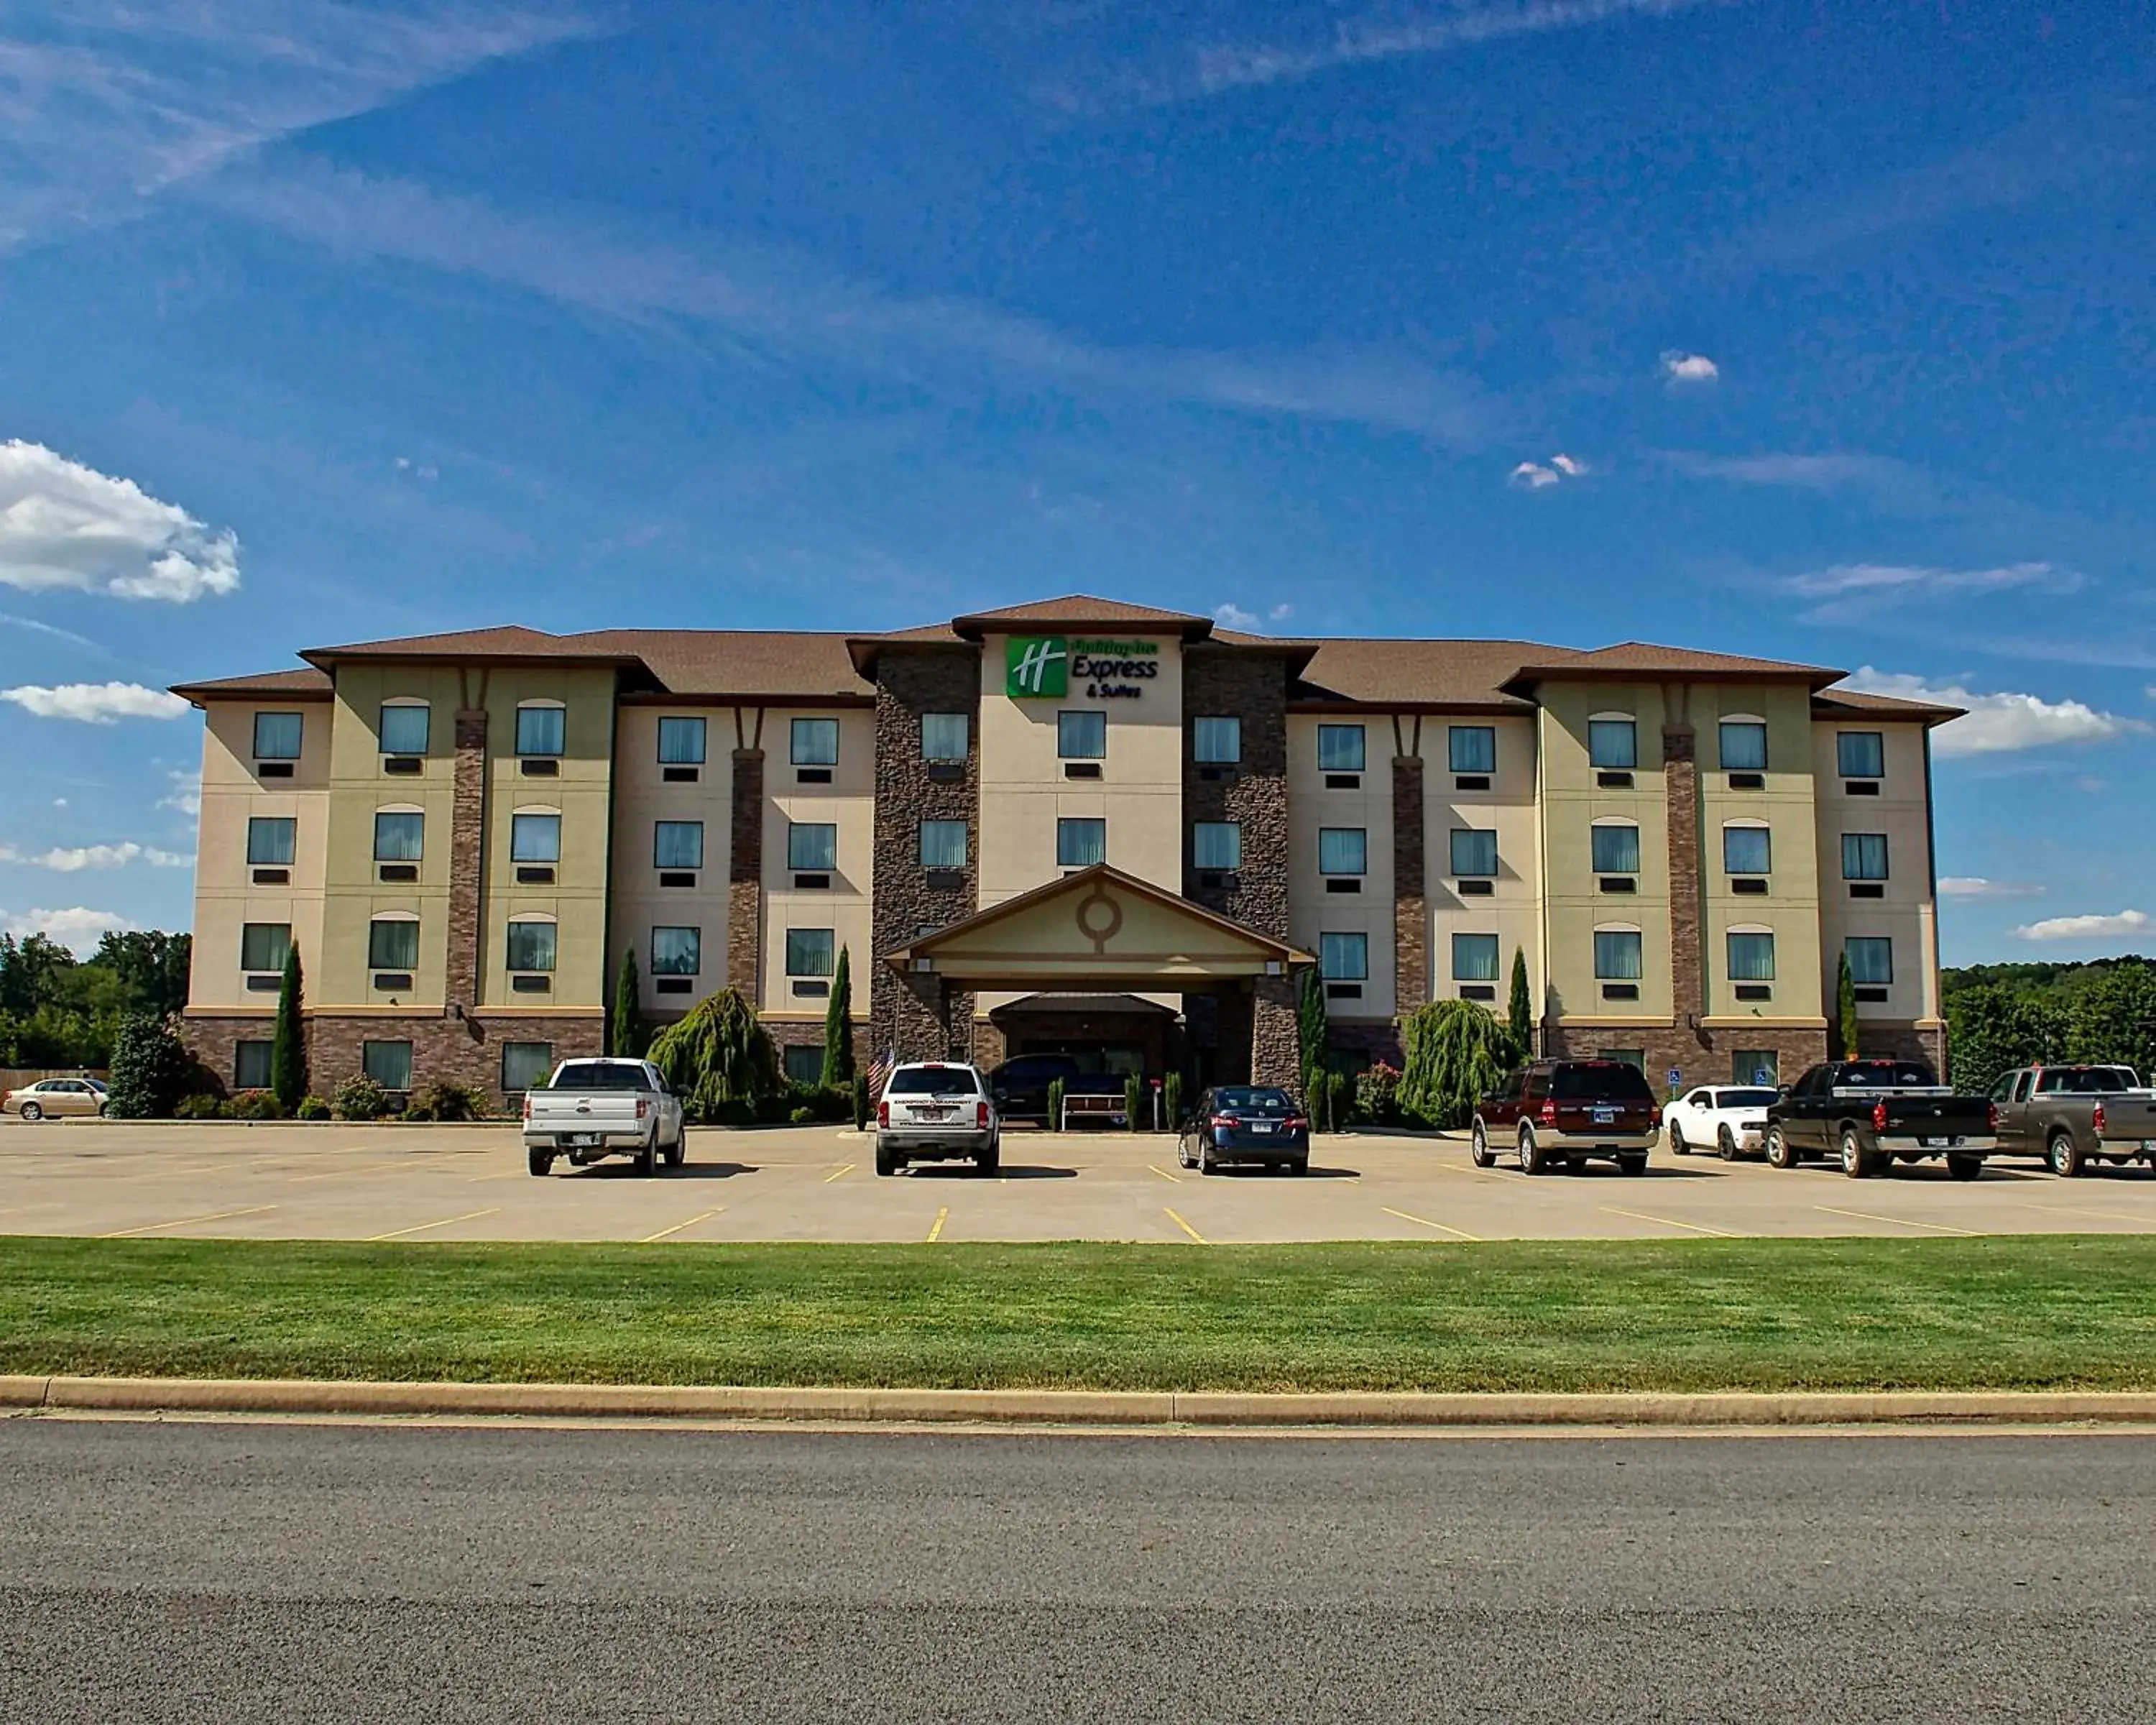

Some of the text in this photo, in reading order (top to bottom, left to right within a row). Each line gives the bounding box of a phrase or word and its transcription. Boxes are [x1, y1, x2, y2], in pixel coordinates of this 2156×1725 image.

[1072, 656, 1158, 683] Express
[1087, 683, 1141, 699] & Suites
